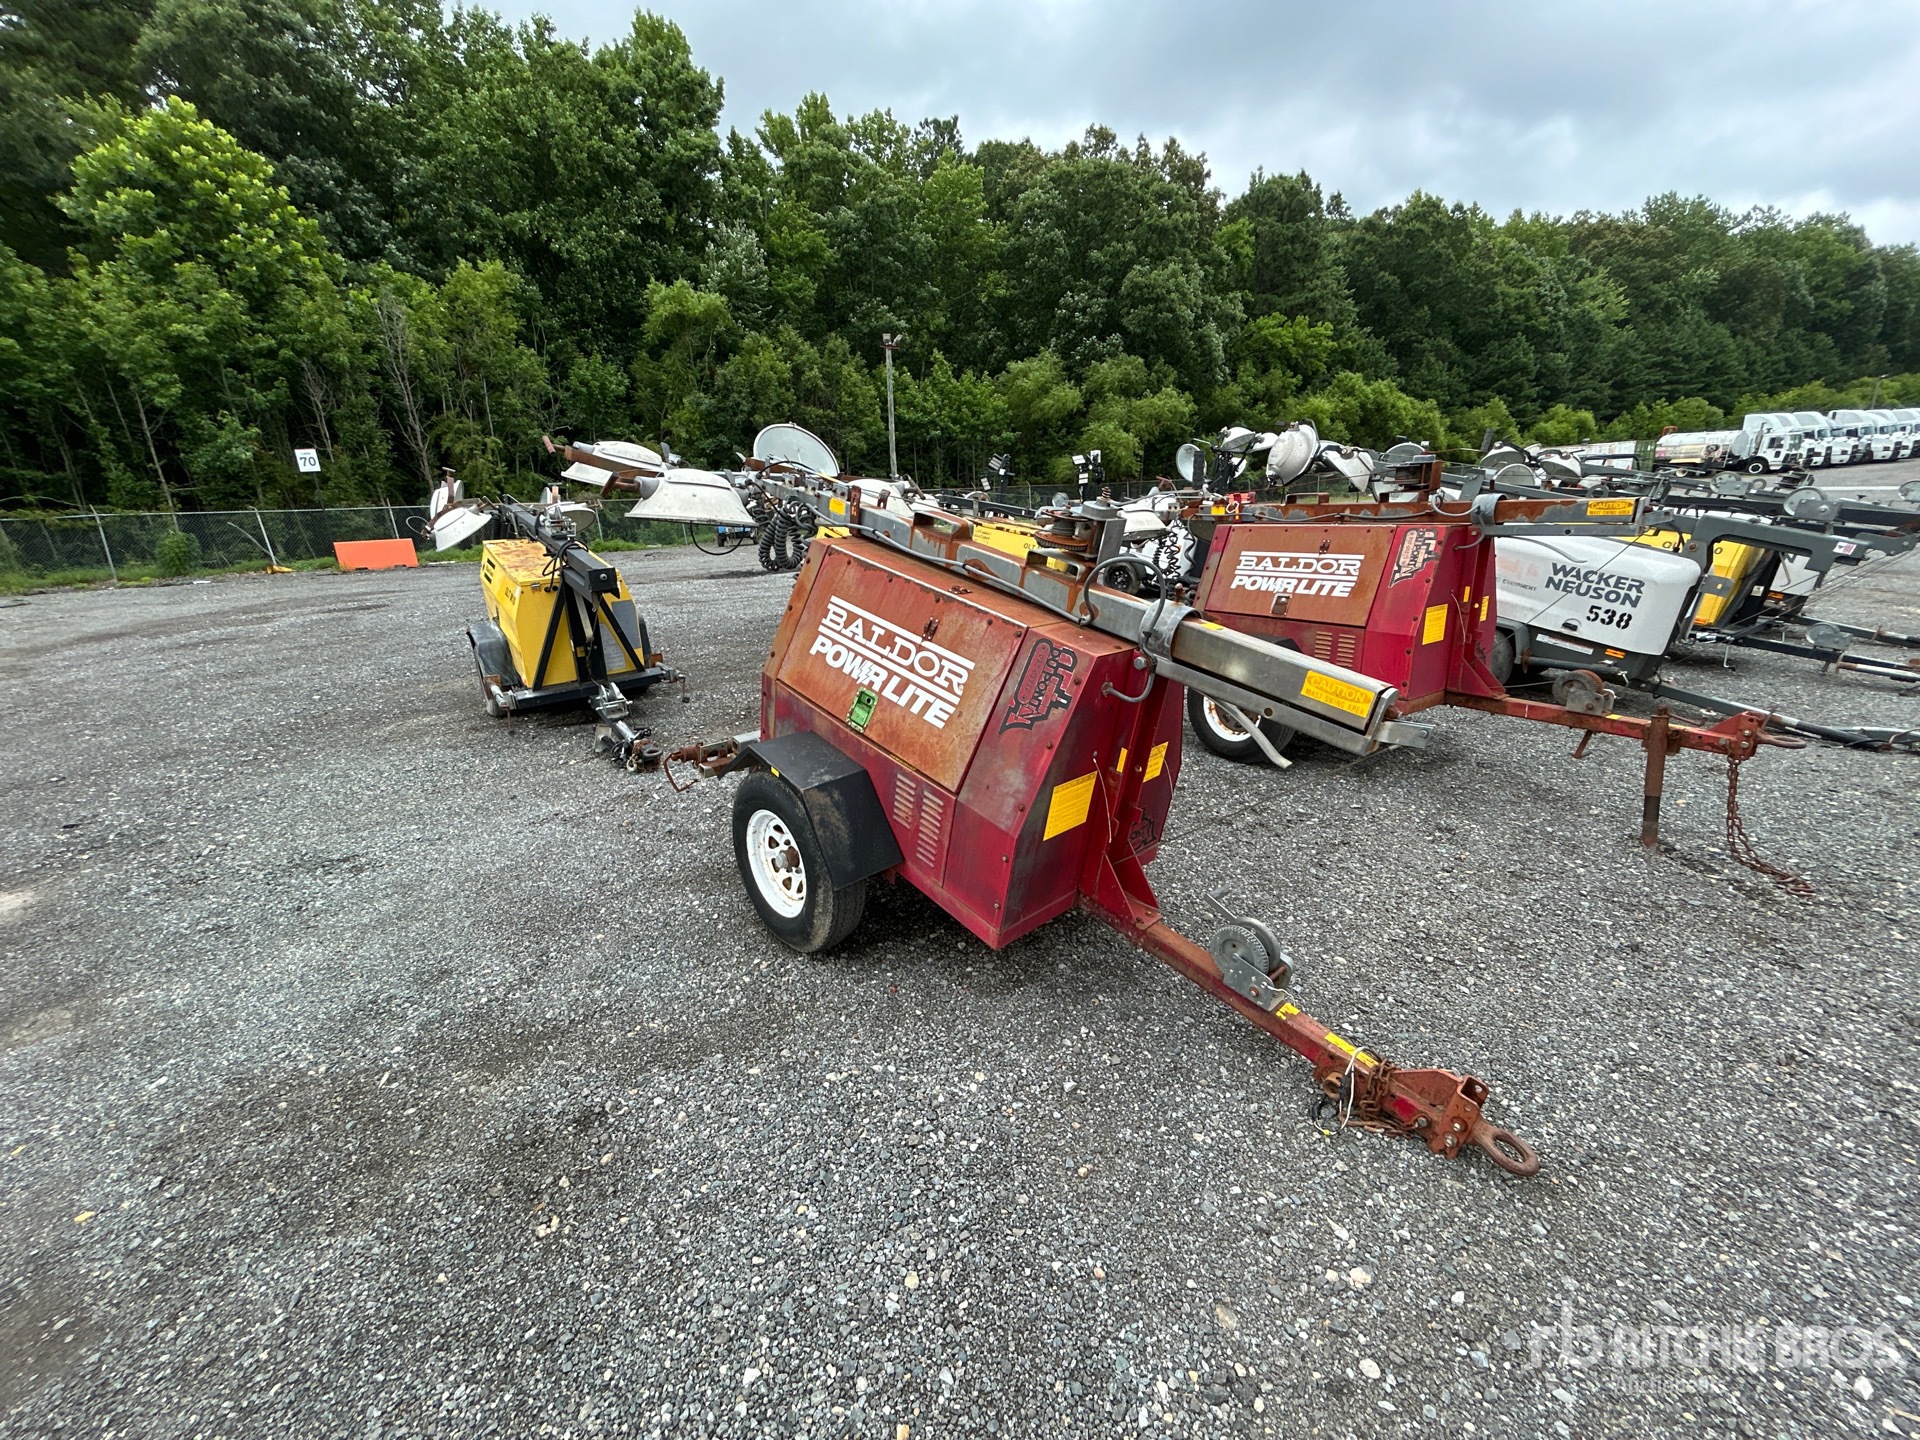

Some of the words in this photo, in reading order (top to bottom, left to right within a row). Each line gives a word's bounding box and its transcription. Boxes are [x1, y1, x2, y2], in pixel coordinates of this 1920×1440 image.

[299, 457, 316, 466] 70
[1236, 556, 1361, 576] BALDOR
[1552, 563, 1645, 594] WACKER
[1545, 576, 1642, 608] NEUSON
[1586, 605, 1632, 629] 538
[821, 603, 969, 696] BALDOR
[1306, 688, 1322, 699] MAST
[1326, 696, 1345, 709] SWING
[1347, 703, 1364, 715] AREA
[1311, 677, 1366, 703] CAUTION
